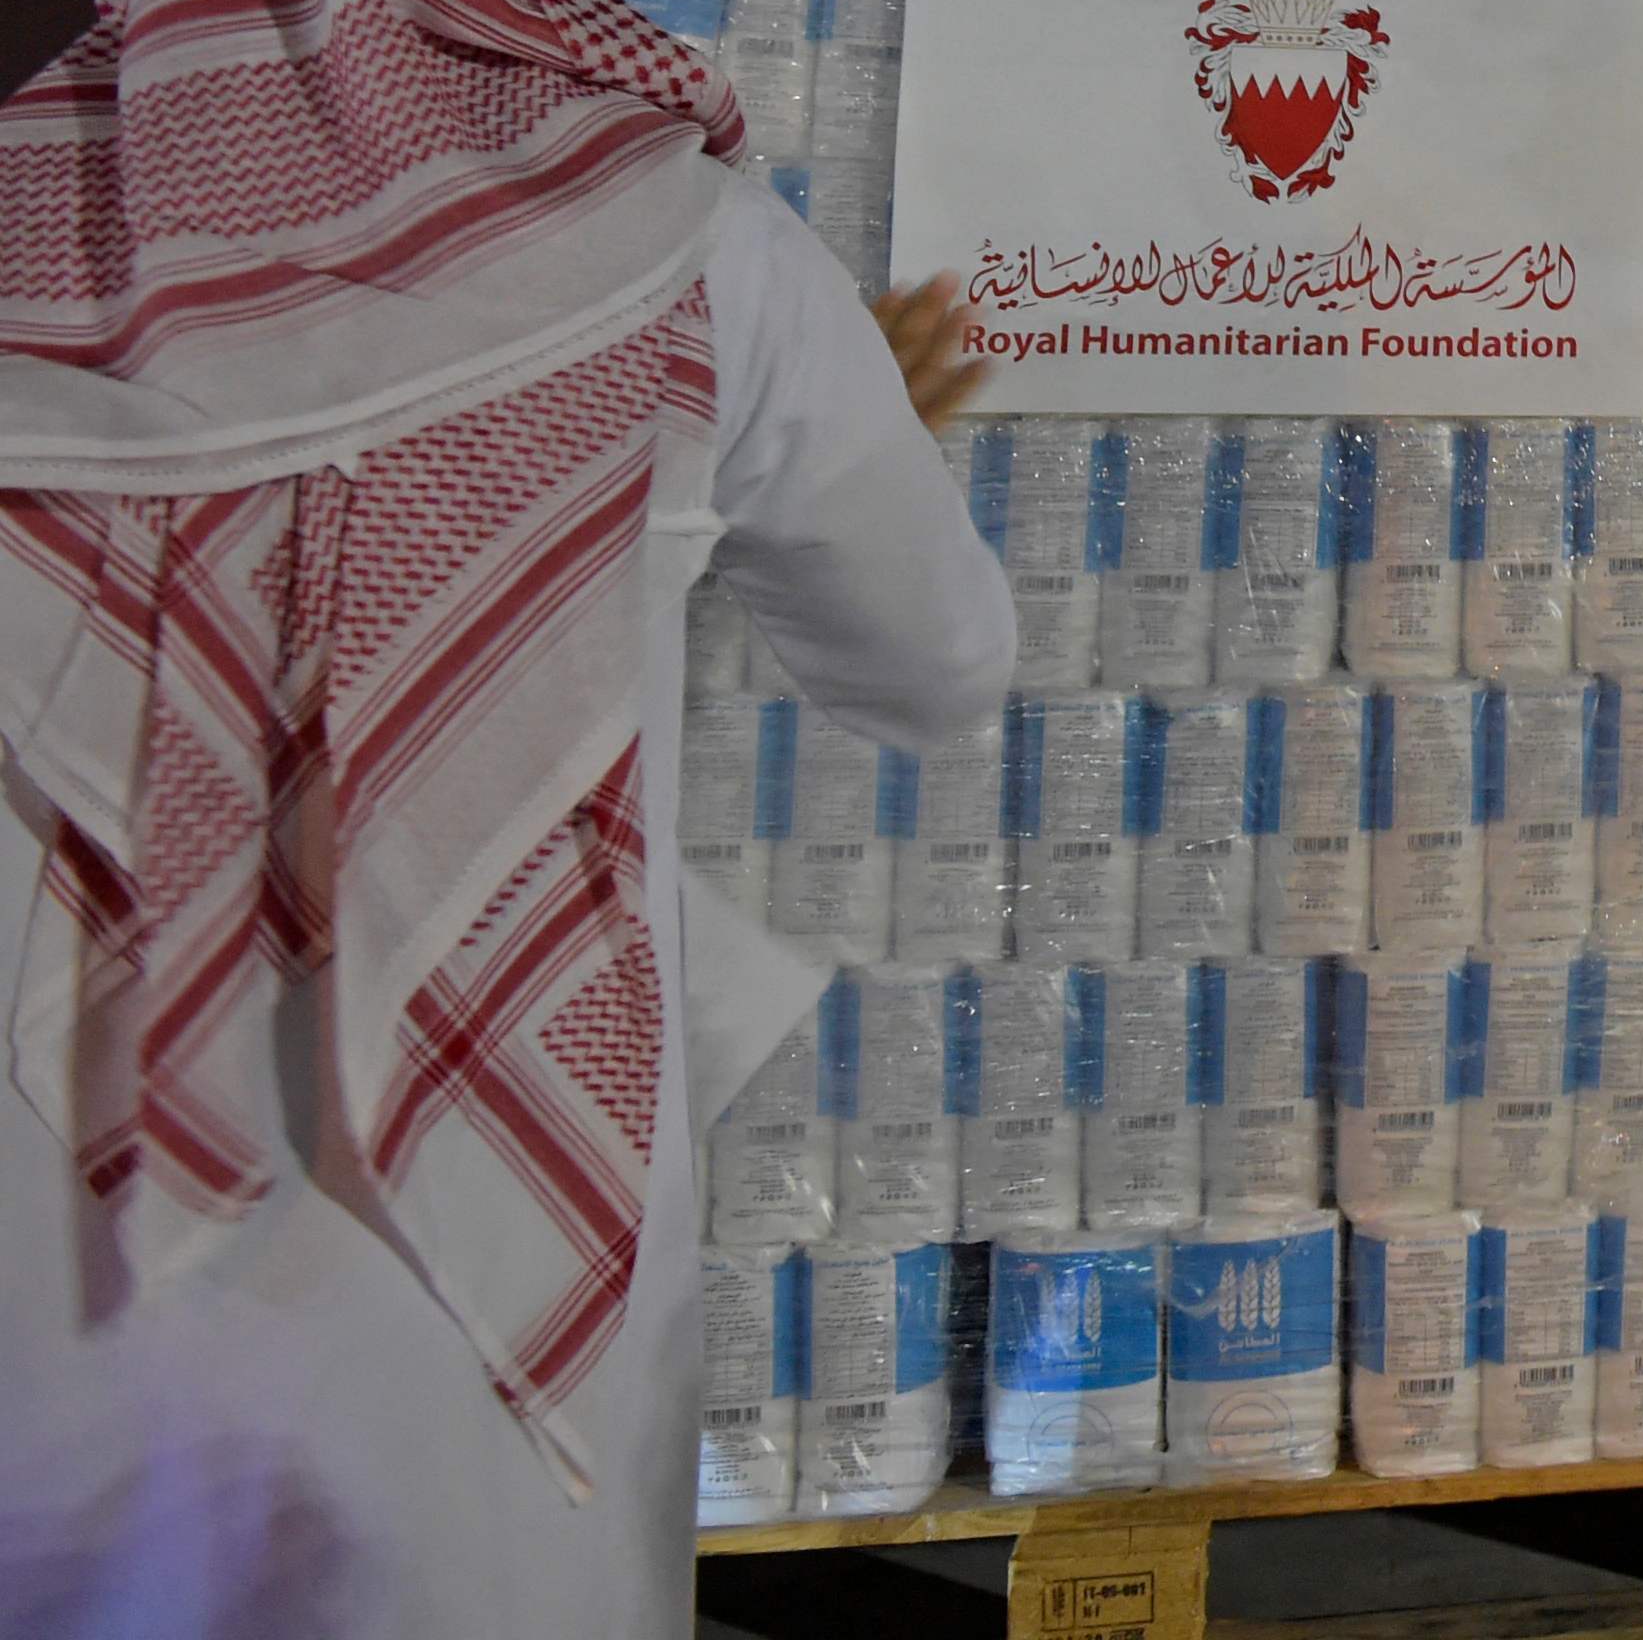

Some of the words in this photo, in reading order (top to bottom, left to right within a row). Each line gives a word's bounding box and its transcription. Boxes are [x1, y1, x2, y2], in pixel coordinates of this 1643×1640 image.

[962, 324, 1069, 362] Royal
[1082, 325, 1348, 356] Humanitarian
[1362, 327, 1577, 357] Foundation
